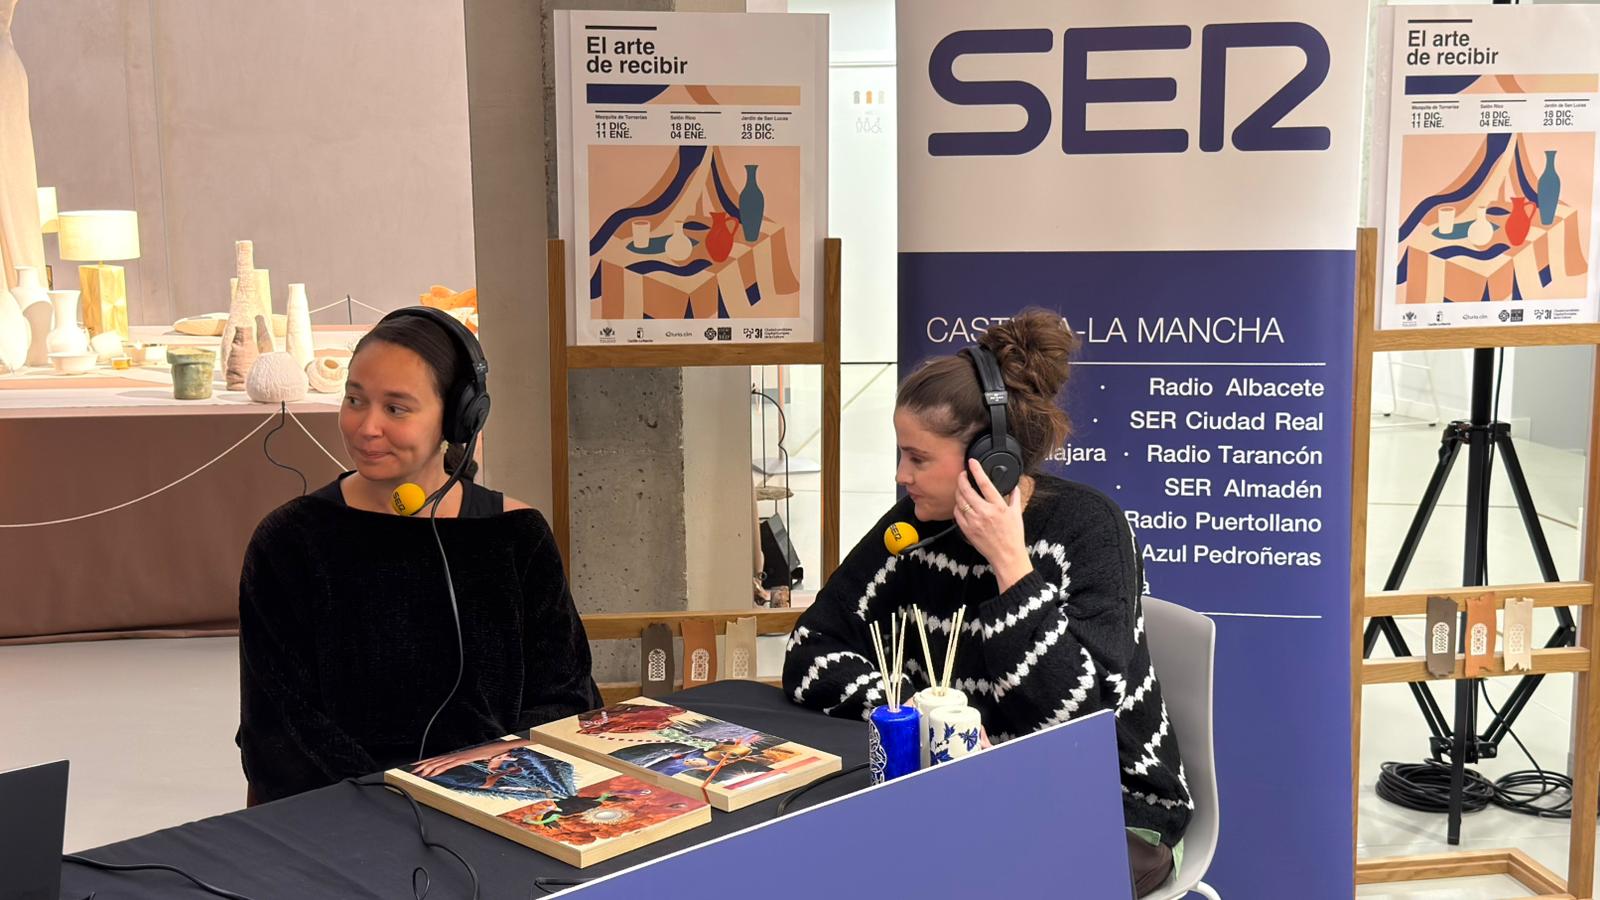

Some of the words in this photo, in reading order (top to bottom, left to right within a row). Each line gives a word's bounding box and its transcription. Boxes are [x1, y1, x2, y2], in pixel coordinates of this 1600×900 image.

[1408, 30, 1426, 47] El
[1433, 31, 1470, 47] arte
[587, 36, 607, 54] El
[614, 38, 655, 55] arte
[1407, 48, 1430, 65] de
[1437, 48, 1499, 65] recibir
[587, 56, 613, 73] de
[620, 56, 688, 74] recibir
[928, 22, 1331, 156] SER
[1412, 112, 1421, 120] 11
[1424, 112, 1442, 120] DIC.
[1480, 111, 1490, 119] 18
[1492, 111, 1510, 119] DIC.
[1544, 110, 1554, 118] 18
[1556, 110, 1574, 118] DIC.
[596, 122, 606, 130] 11
[609, 122, 630, 130] DIC.
[671, 123, 681, 131] 18
[684, 123, 704, 131] DIC.
[742, 123, 752, 131] 18
[754, 123, 774, 131] DIC.
[1412, 120, 1421, 128] 11
[1423, 120, 1444, 128] ENE.
[1479, 119, 1490, 127] 04
[1492, 119, 1512, 127] ENE.
[1543, 118, 1553, 126] 23
[1556, 118, 1573, 126] DIC.
[596, 130, 606, 138] 11
[609, 130, 632, 139] ENE.
[670, 131, 681, 139] 04
[684, 131, 706, 139] ENE.
[741, 131, 752, 139] 23
[754, 131, 774, 139] DIC.
[1137, 316, 1285, 344] MANCHA
[1149, 378, 1213, 397] Radio
[1226, 378, 1325, 398] Albacete
[1130, 411, 1177, 430] SER
[1185, 411, 1265, 431] Ciudad
[1275, 412, 1323, 431] Real
[1147, 445, 1211, 464] Radio
[1218, 445, 1323, 465] Tarancón
[1165, 479, 1211, 496] SER
[1224, 478, 1322, 499] Almadén
[1124, 511, 1187, 530] Radio
[1195, 511, 1322, 533] Puertollano
[1142, 544, 1187, 562] Azul
[1194, 545, 1322, 567] Pedroñeras
